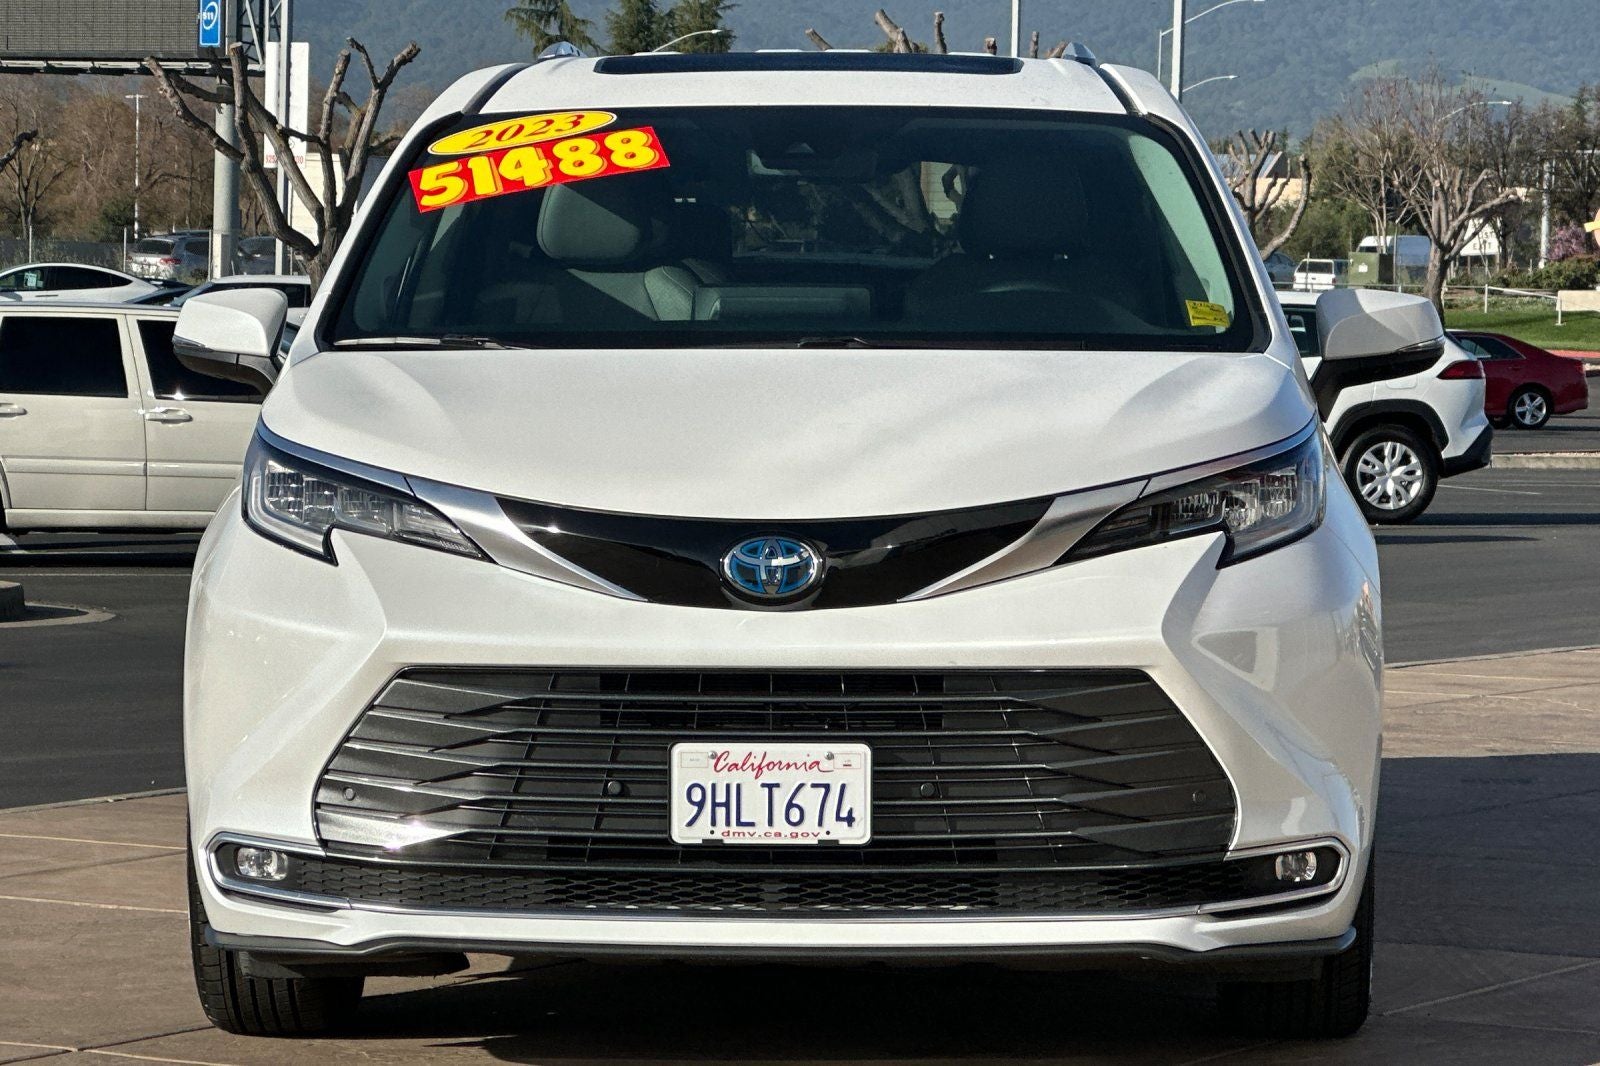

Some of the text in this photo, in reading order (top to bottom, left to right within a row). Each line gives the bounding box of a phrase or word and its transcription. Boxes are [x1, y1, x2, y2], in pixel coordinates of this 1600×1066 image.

[202, 12, 214, 20] 511
[465, 114, 585, 149] 2023
[420, 130, 660, 207] 51488
[713, 750, 835, 780] California
[685, 782, 856, 828] 9HLT674
[721, 830, 821, 839] dmv.ca.gov
